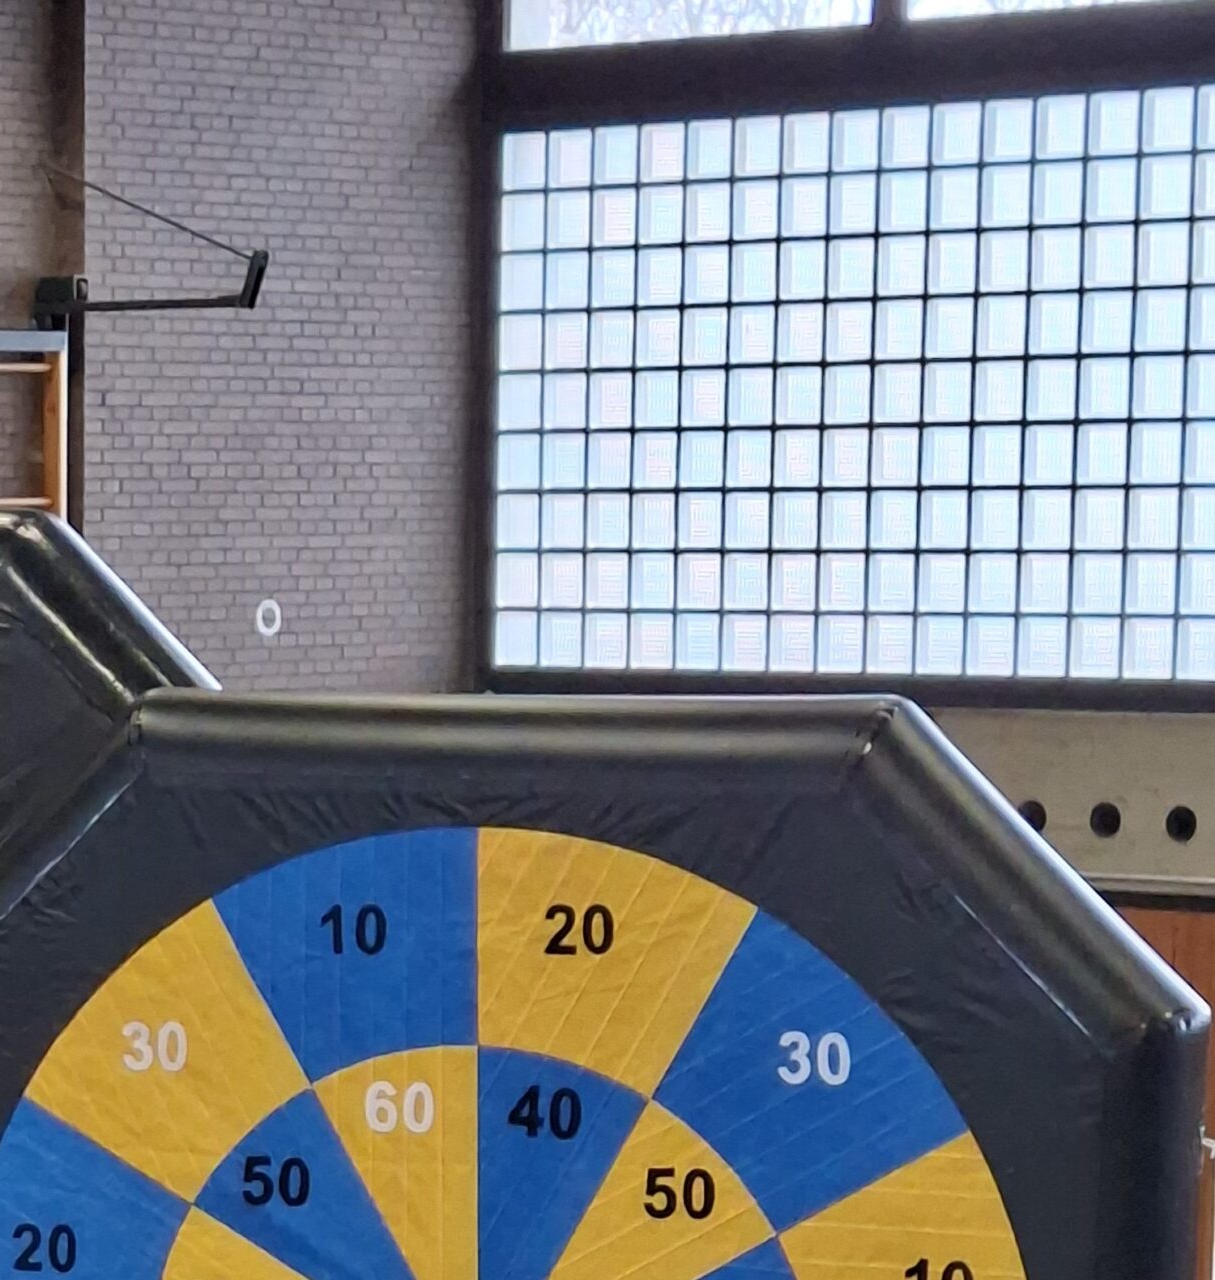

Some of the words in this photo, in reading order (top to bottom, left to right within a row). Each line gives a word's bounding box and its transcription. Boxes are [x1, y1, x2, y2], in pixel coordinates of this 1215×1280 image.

[321, 905, 387, 956] 10
[543, 903, 615, 956] 20
[122, 1021, 187, 1072] 30
[777, 1030, 851, 1086] 30
[364, 1080, 435, 1134] 60
[507, 1085, 582, 1141] 40
[242, 1155, 311, 1207] 50
[643, 1167, 716, 1221] 50
[13, 1224, 77, 1274] 20
